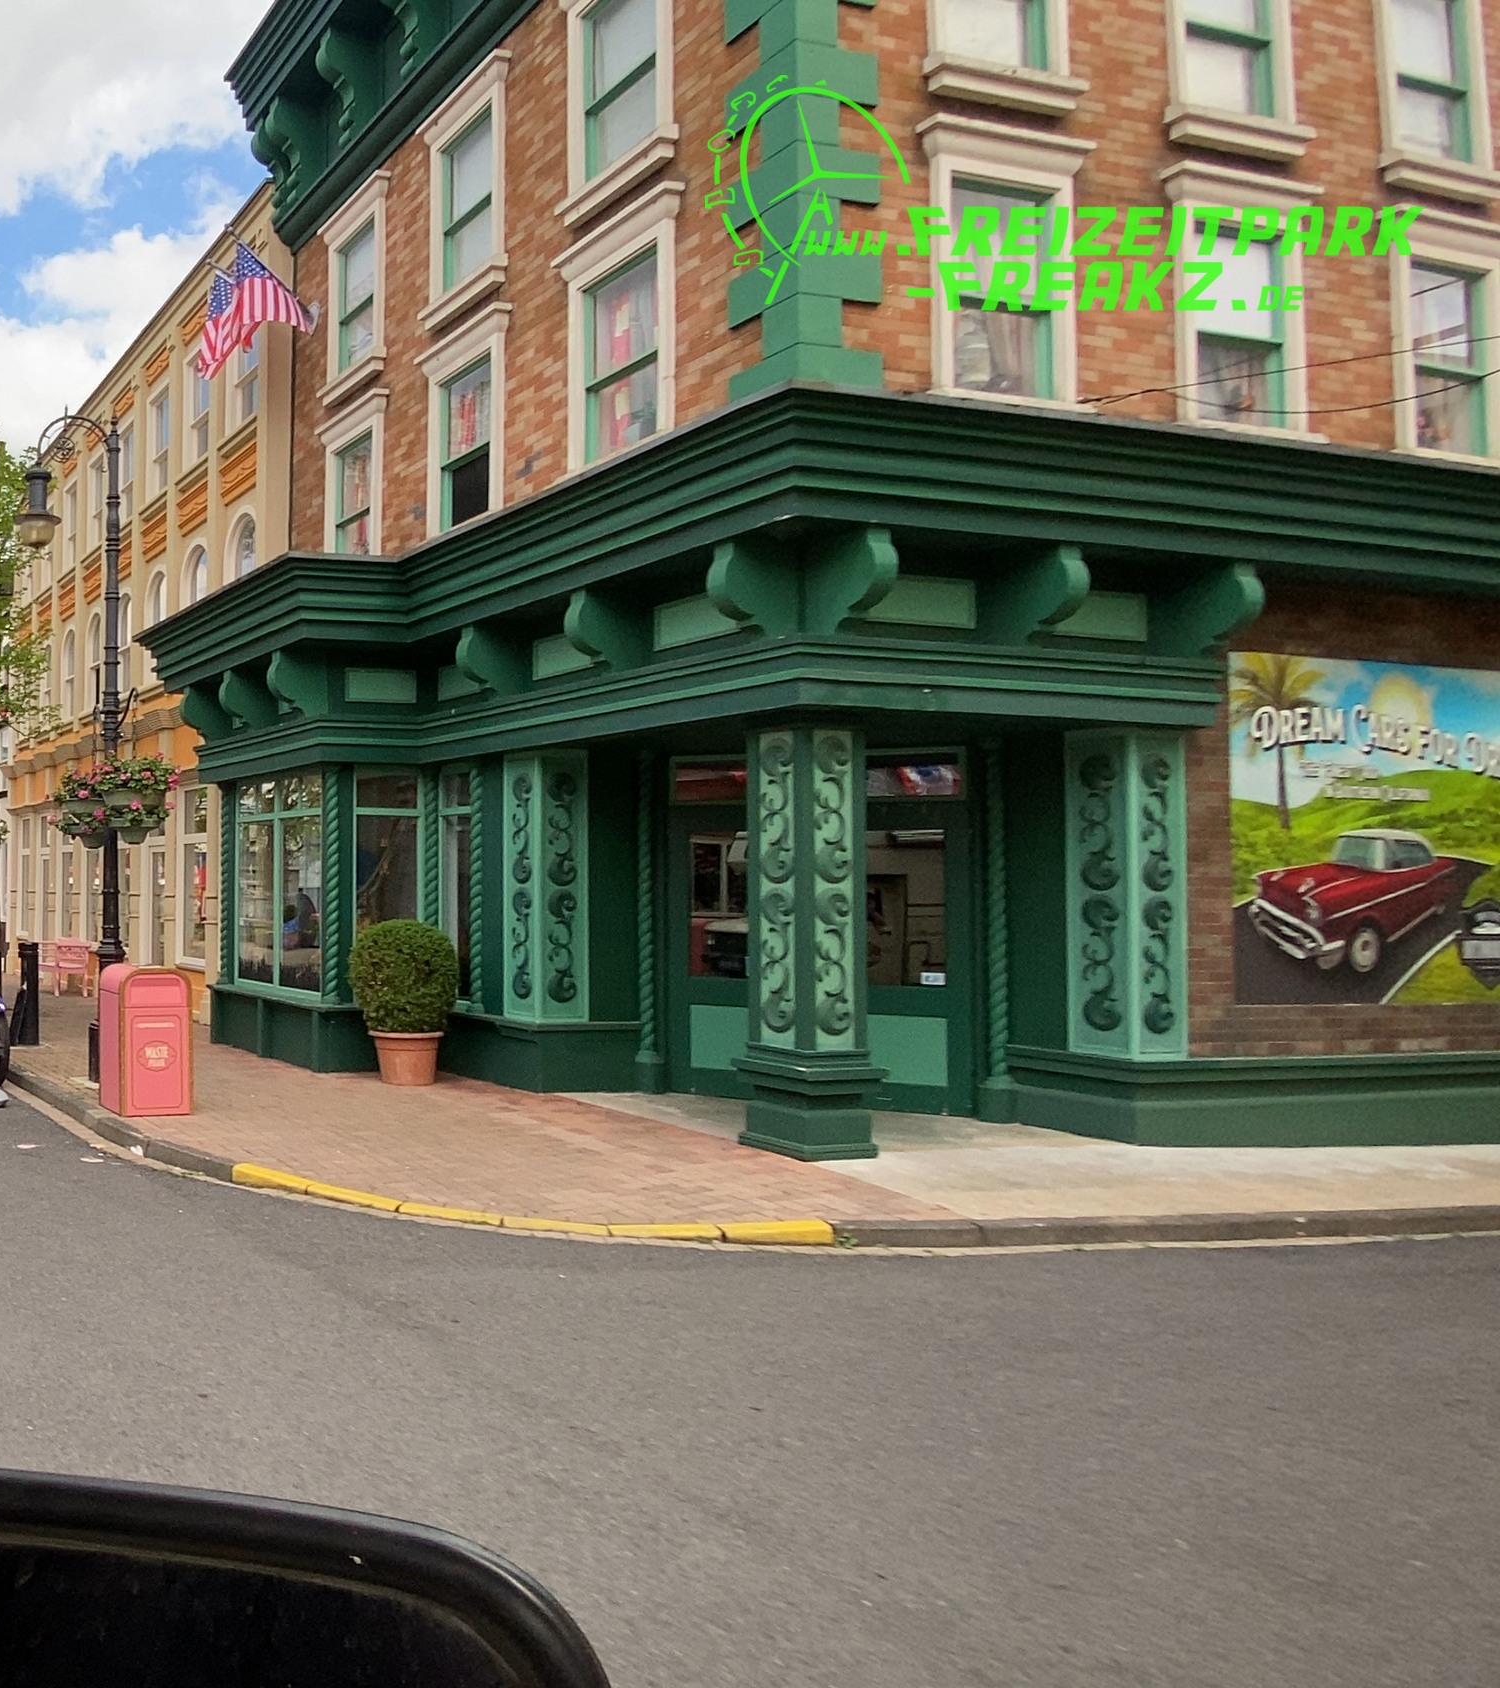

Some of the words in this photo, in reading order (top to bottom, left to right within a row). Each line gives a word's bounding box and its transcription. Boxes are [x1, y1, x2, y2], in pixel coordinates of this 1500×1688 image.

[1250, 704, 1347, 752] DREAM
[1351, 703, 1411, 756] CARS
[1417, 723, 1460, 769] FOR
